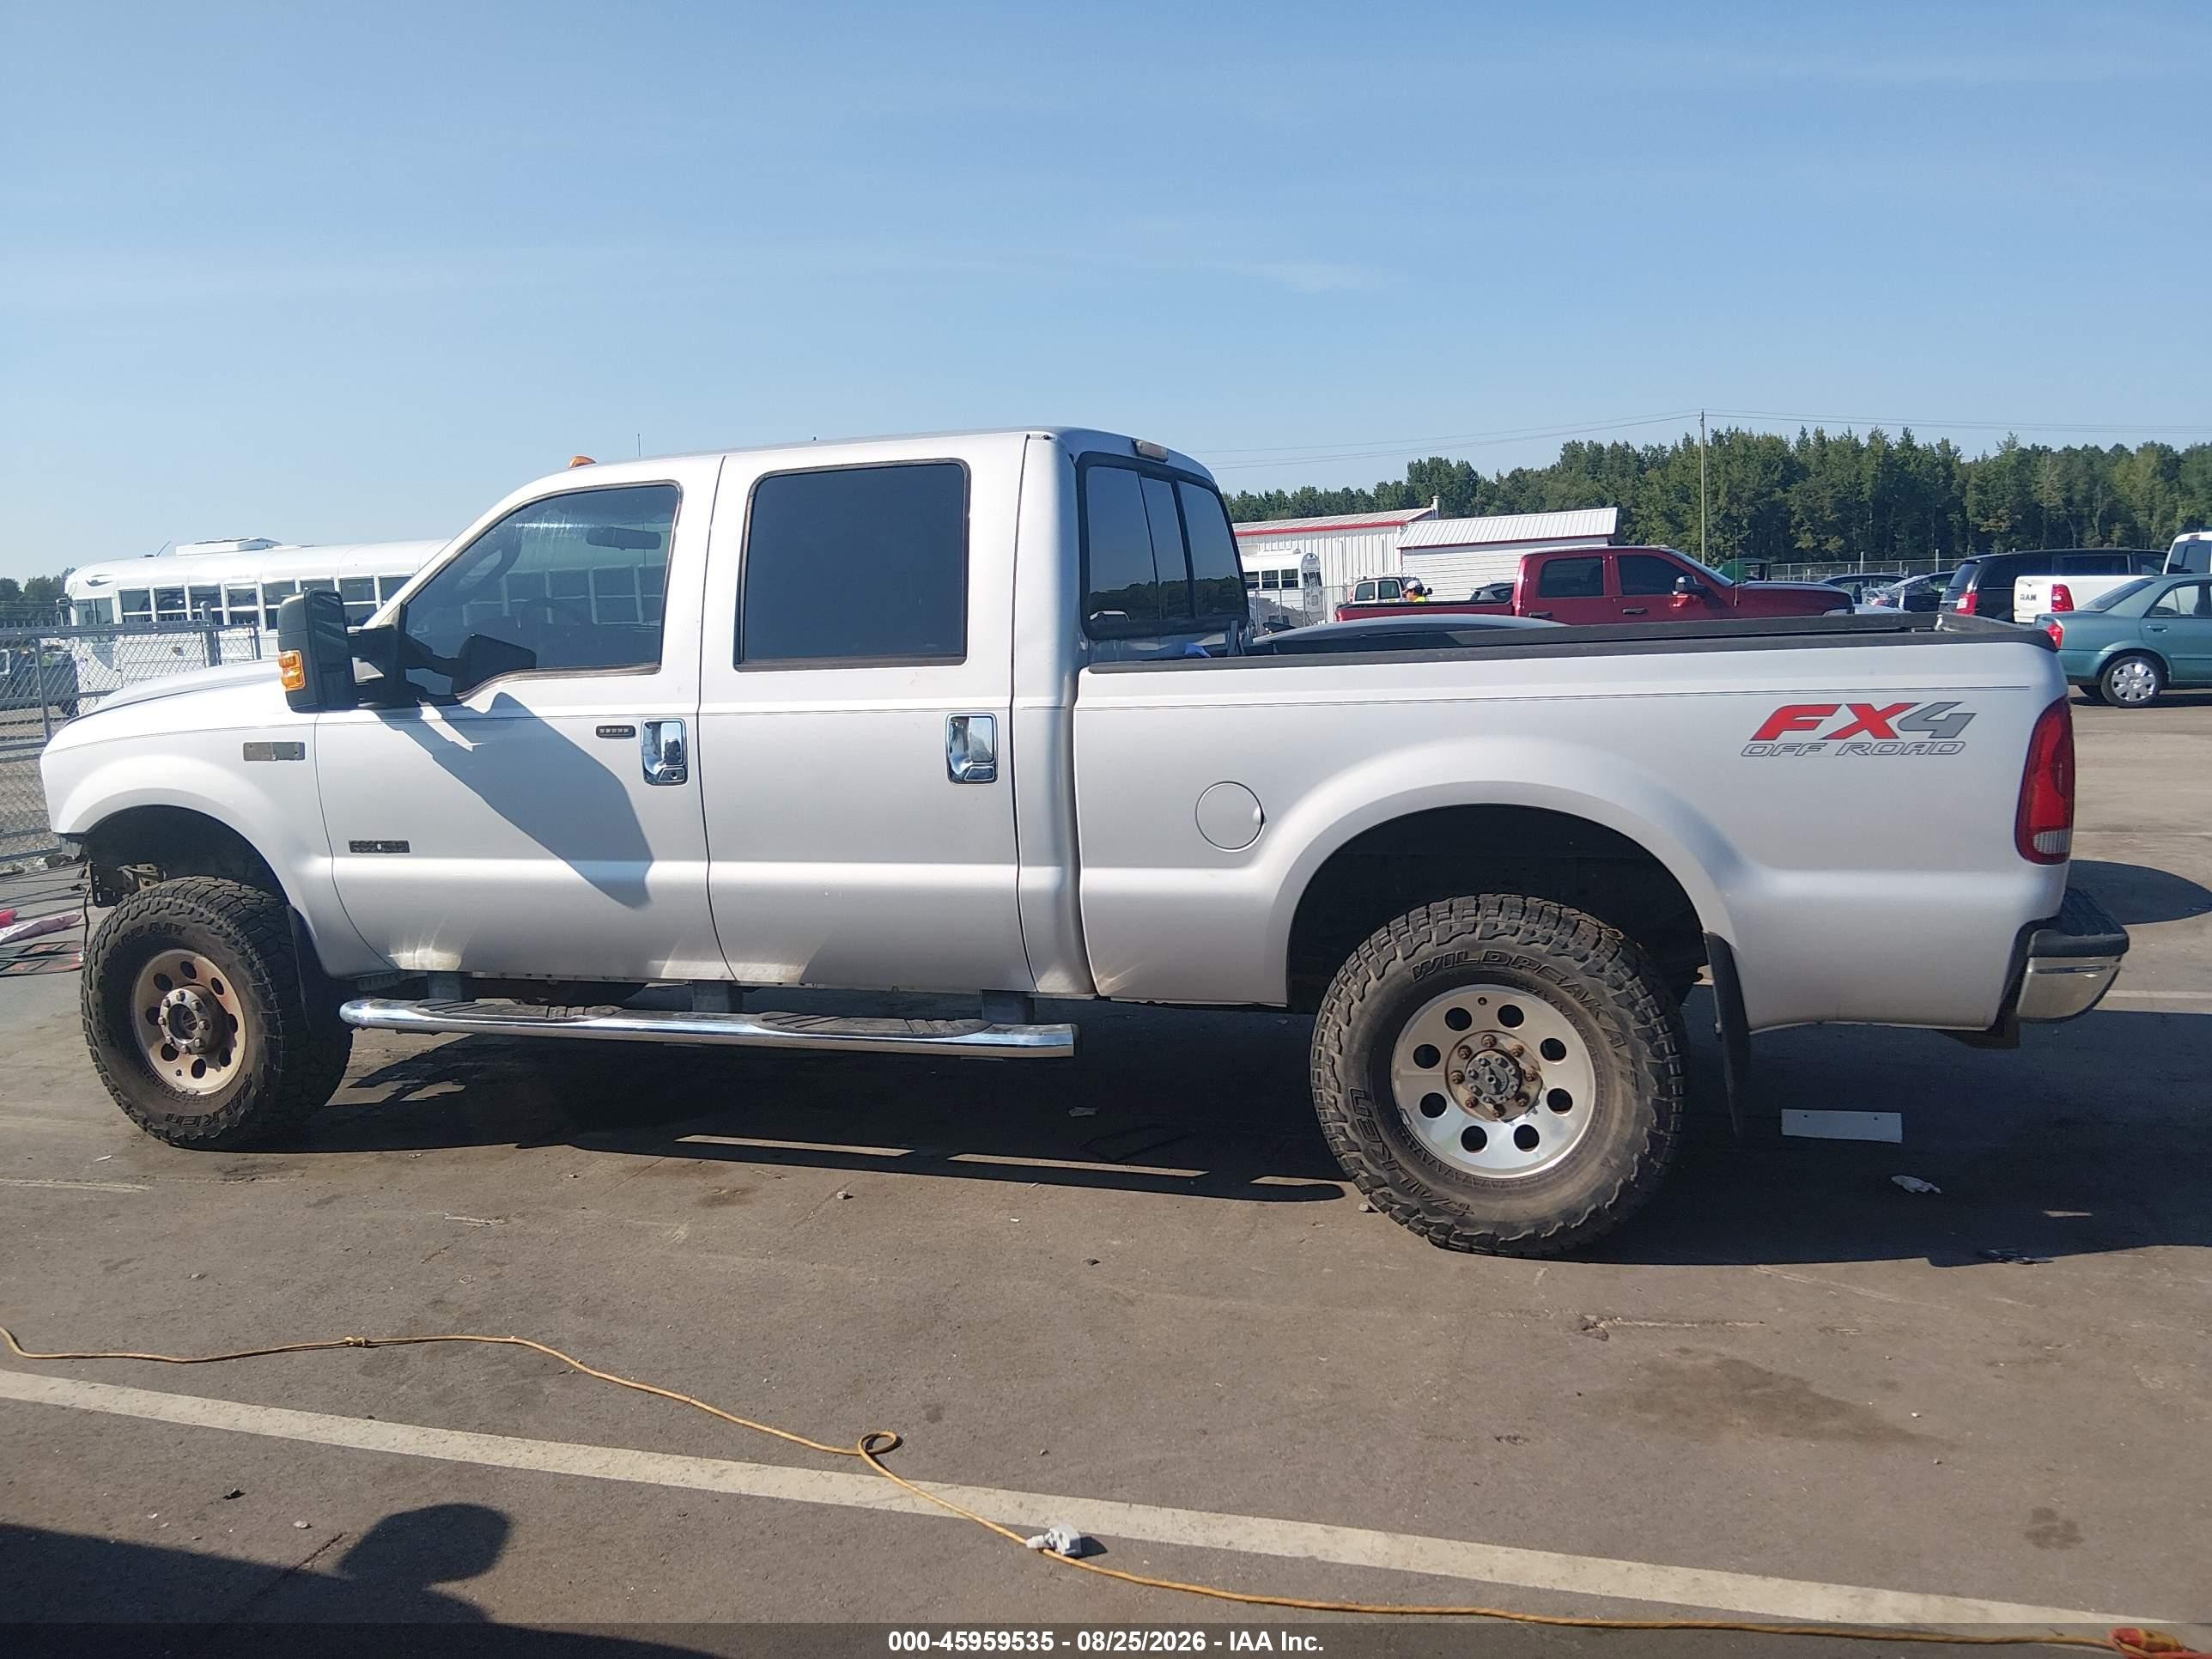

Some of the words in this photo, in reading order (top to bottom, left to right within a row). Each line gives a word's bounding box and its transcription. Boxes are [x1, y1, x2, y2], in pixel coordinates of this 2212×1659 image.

[1741, 742, 1828, 757] OFF
[1835, 741, 1966, 756] ROAD
[1750, 702, 1978, 741] FX4
[1412, 950, 1616, 1024] WILDPEAK
[1349, 1087, 1474, 1215] FALKEN
